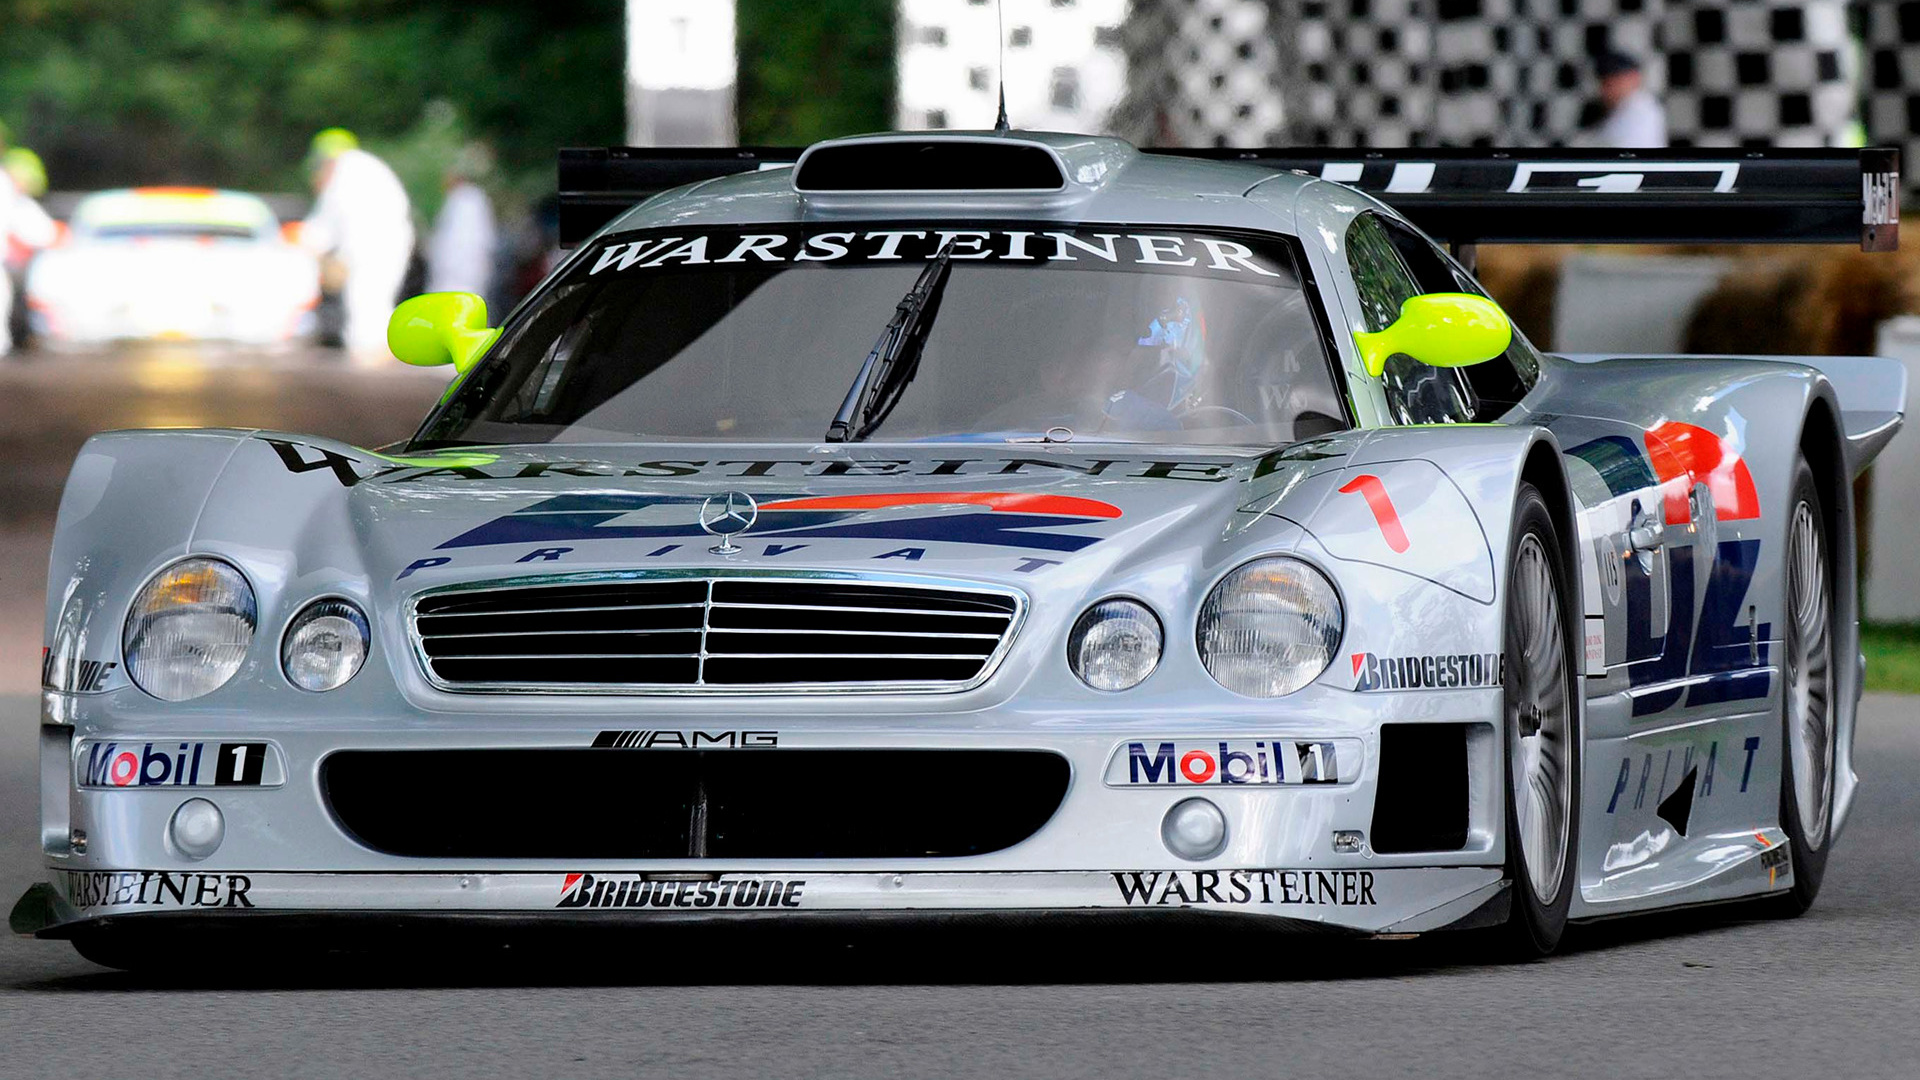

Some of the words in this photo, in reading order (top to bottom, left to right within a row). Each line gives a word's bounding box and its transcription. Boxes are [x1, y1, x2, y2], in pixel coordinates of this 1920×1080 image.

[590, 230, 1280, 279] WARSTEINER
[256, 438, 1348, 487] WARSTEINER
[1338, 474, 1411, 554] 1
[397, 543, 1064, 580] PRIVAT
[644, 730, 779, 749] AMG
[86, 742, 204, 787] Mobil
[230, 745, 248, 782] 1
[1128, 741, 1286, 784] Mobil
[1308, 743, 1326, 781] 1
[67, 871, 256, 910] WARSTEINER
[555, 872, 806, 908] BRIDGESTONE
[1110, 870, 1377, 906] WARSTEINER
